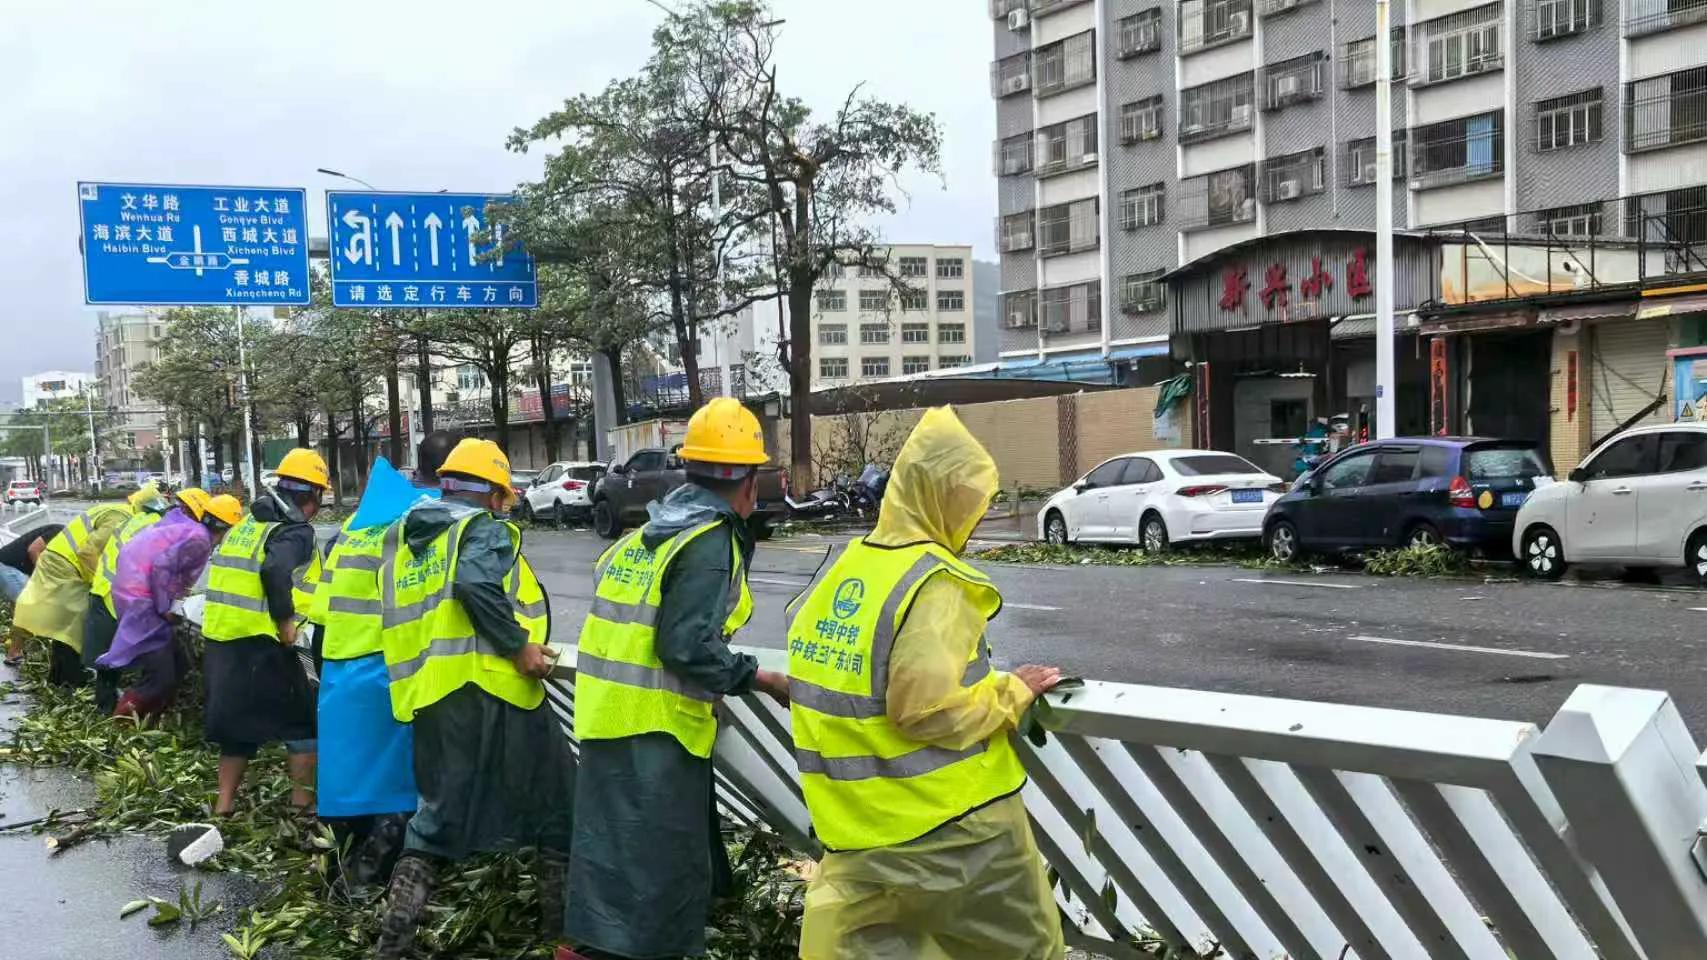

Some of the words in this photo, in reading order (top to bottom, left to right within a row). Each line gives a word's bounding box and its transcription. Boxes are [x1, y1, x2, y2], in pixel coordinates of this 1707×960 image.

[121, 193, 180, 211] 文华路
[213, 196, 290, 214] 工业大道
[120, 212, 163, 223] Wenhua
[167, 213, 180, 223] Rd
[219, 214, 258, 226] Gongye
[260, 214, 284, 225] Blvd
[93, 224, 174, 242] 海滨大道
[222, 227, 298, 244] 西城大道
[103, 244, 140, 253] Haibin
[142, 244, 166, 254] Blvd
[227, 245, 269, 256] Xicheng
[271, 245, 295, 256] Blvd
[234, 270, 290, 286] 香城路
[1218, 247, 1373, 311] 新兴小区
[226, 288, 286, 299] Xiangcheng
[288, 288, 302, 298] Rd
[350, 285, 523, 302] 请选定行车方向
